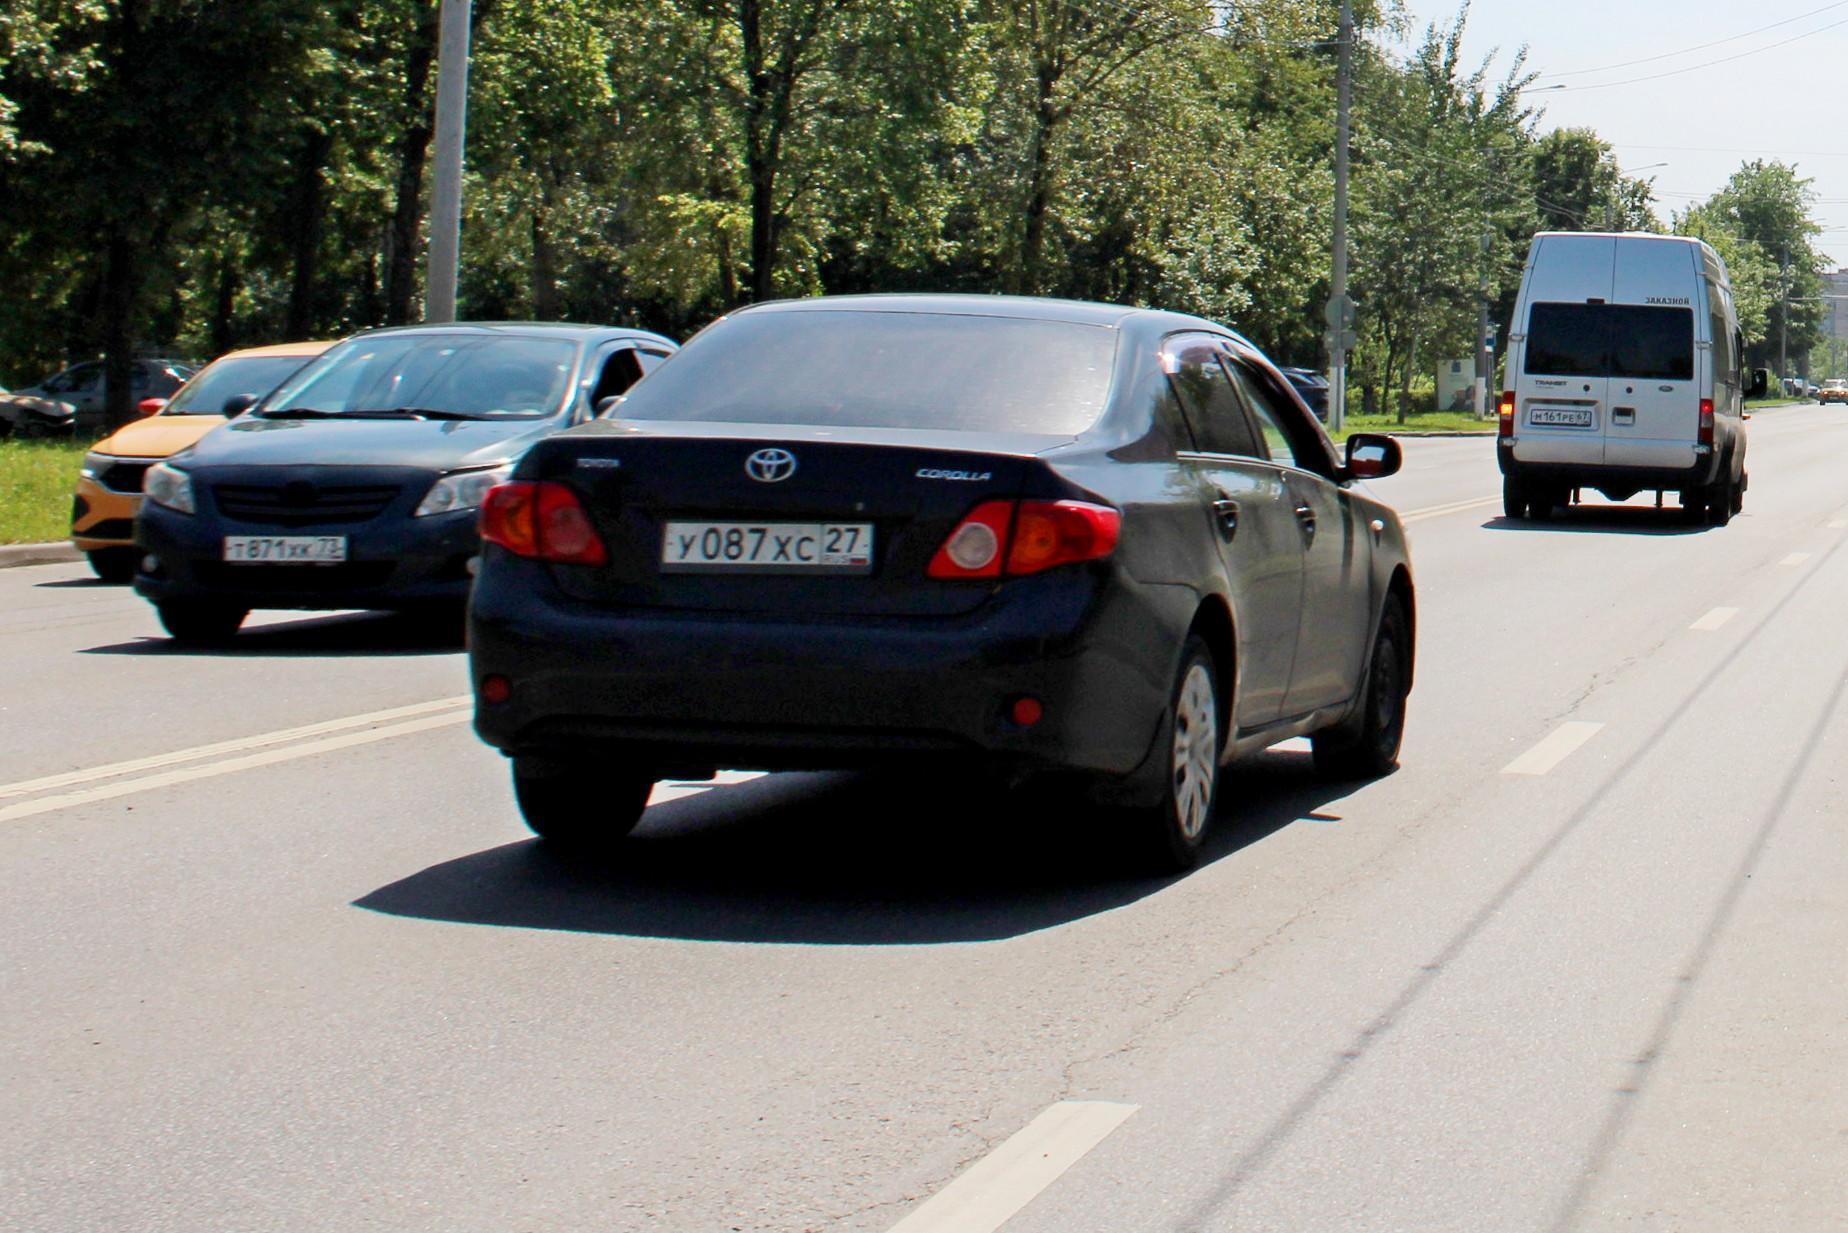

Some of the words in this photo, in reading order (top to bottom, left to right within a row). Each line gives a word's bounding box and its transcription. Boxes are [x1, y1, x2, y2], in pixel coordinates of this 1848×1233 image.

[1644, 296, 1690, 305] ЗАКАЗНОЙ
[915, 468, 992, 481] COROLLA
[825, 527, 861, 554] 27
